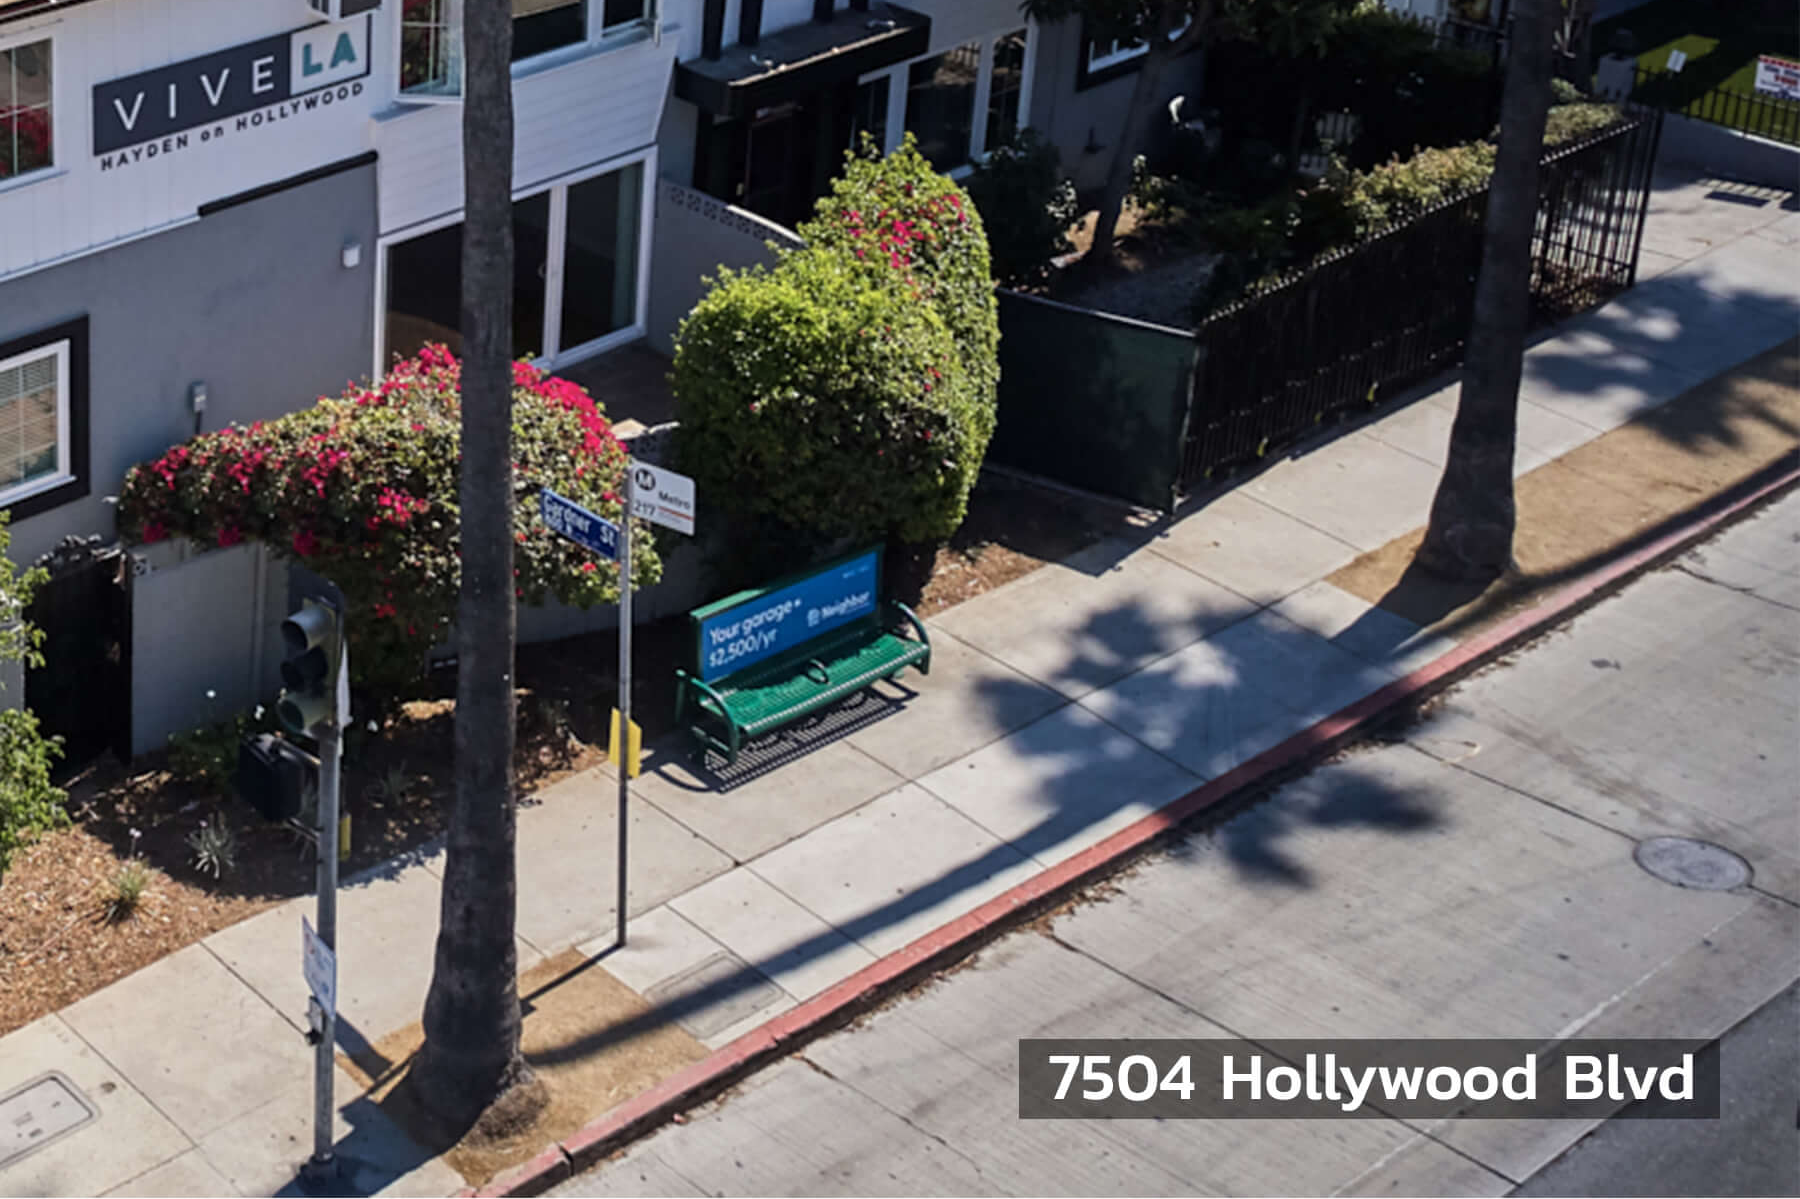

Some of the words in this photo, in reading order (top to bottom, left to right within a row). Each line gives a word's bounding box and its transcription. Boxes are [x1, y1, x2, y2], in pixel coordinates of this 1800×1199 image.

[114, 55, 274, 131] VIVE
[302, 31, 357, 77] LA
[101, 134, 188, 171] HAYDEN
[201, 126, 224, 142] on
[236, 82, 363, 131] HOLLYWOOD
[658, 490, 690, 510] Metro
[600, 525, 615, 547] St
[709, 623, 741, 645] Your
[742, 600, 792, 634] garage
[821, 592, 870, 619] Neighbor
